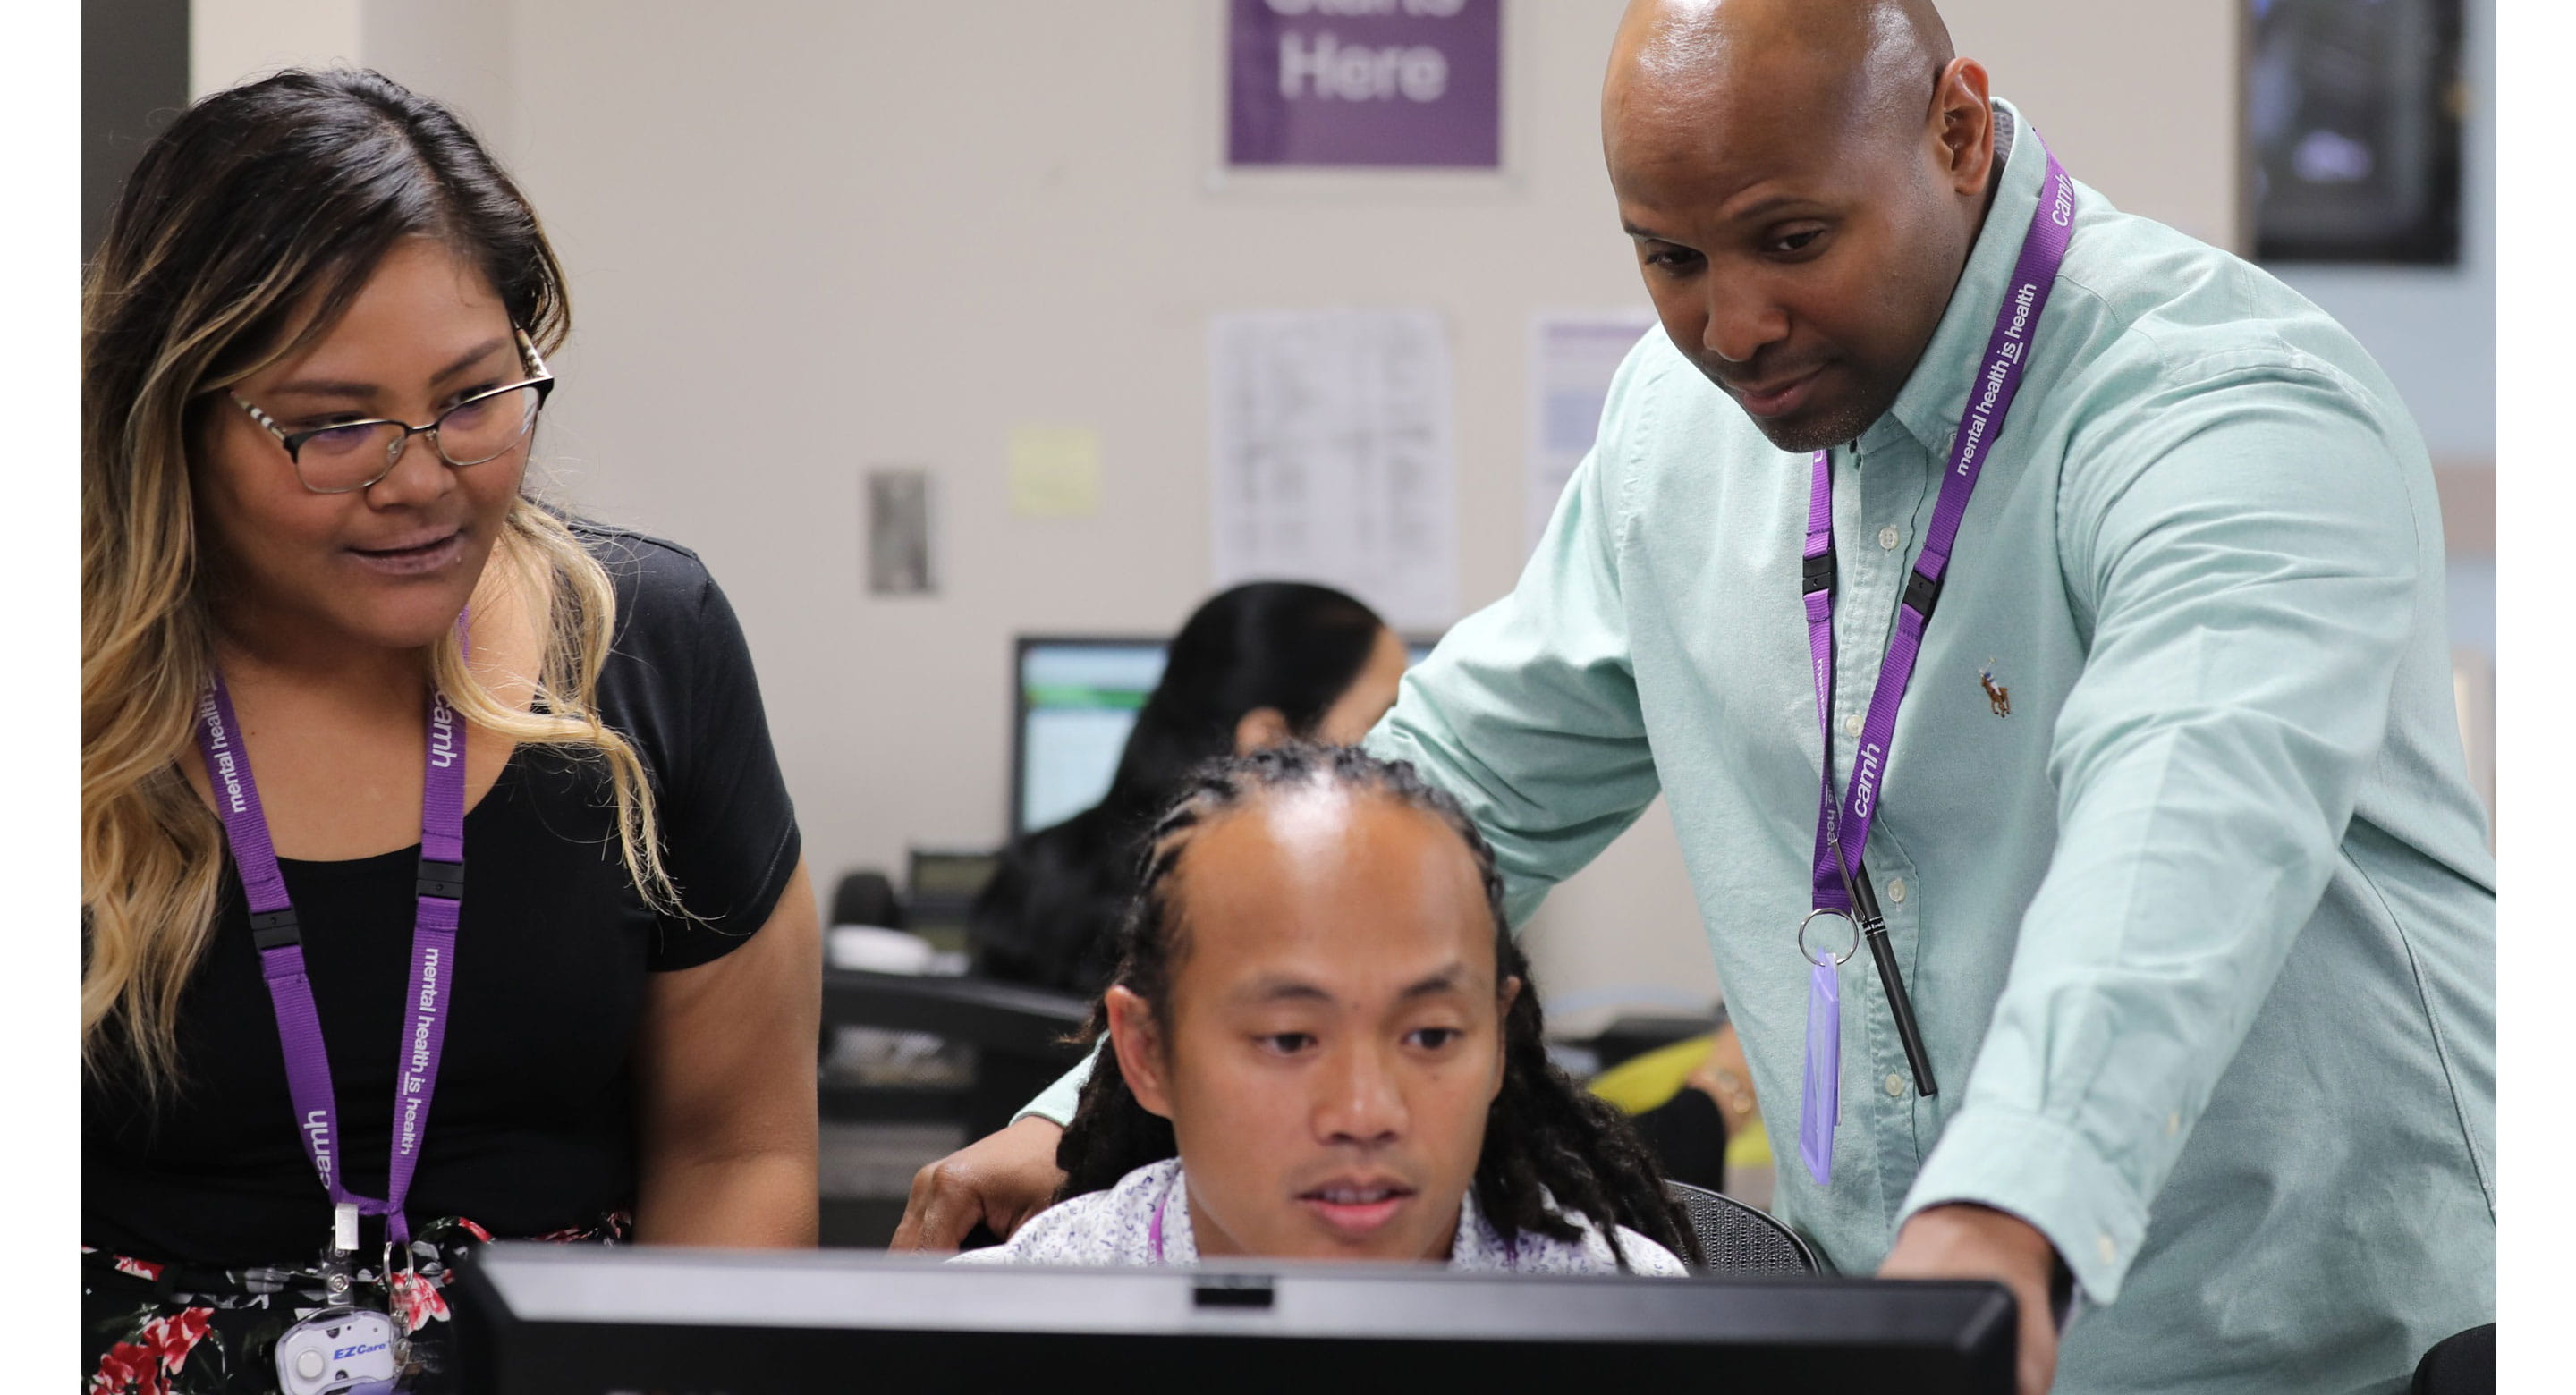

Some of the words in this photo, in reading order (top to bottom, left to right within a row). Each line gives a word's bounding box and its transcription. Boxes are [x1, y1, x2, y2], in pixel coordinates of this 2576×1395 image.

[1278, 30, 1449, 102] Here
[2052, 173, 2073, 227] camh
[2005, 283, 2037, 339] health
[2004, 342, 2021, 364] is
[1975, 359, 2010, 415] health
[1957, 405, 1987, 476] mental
[214, 751, 246, 812] mental
[1855, 743, 1880, 818] camh
[419, 948, 438, 1012] mental
[411, 1016, 435, 1073] health
[405, 1072, 426, 1095] is
[303, 1111, 331, 1190] camh
[401, 1097, 421, 1155] health
[334, 1343, 386, 1359] EZCare
